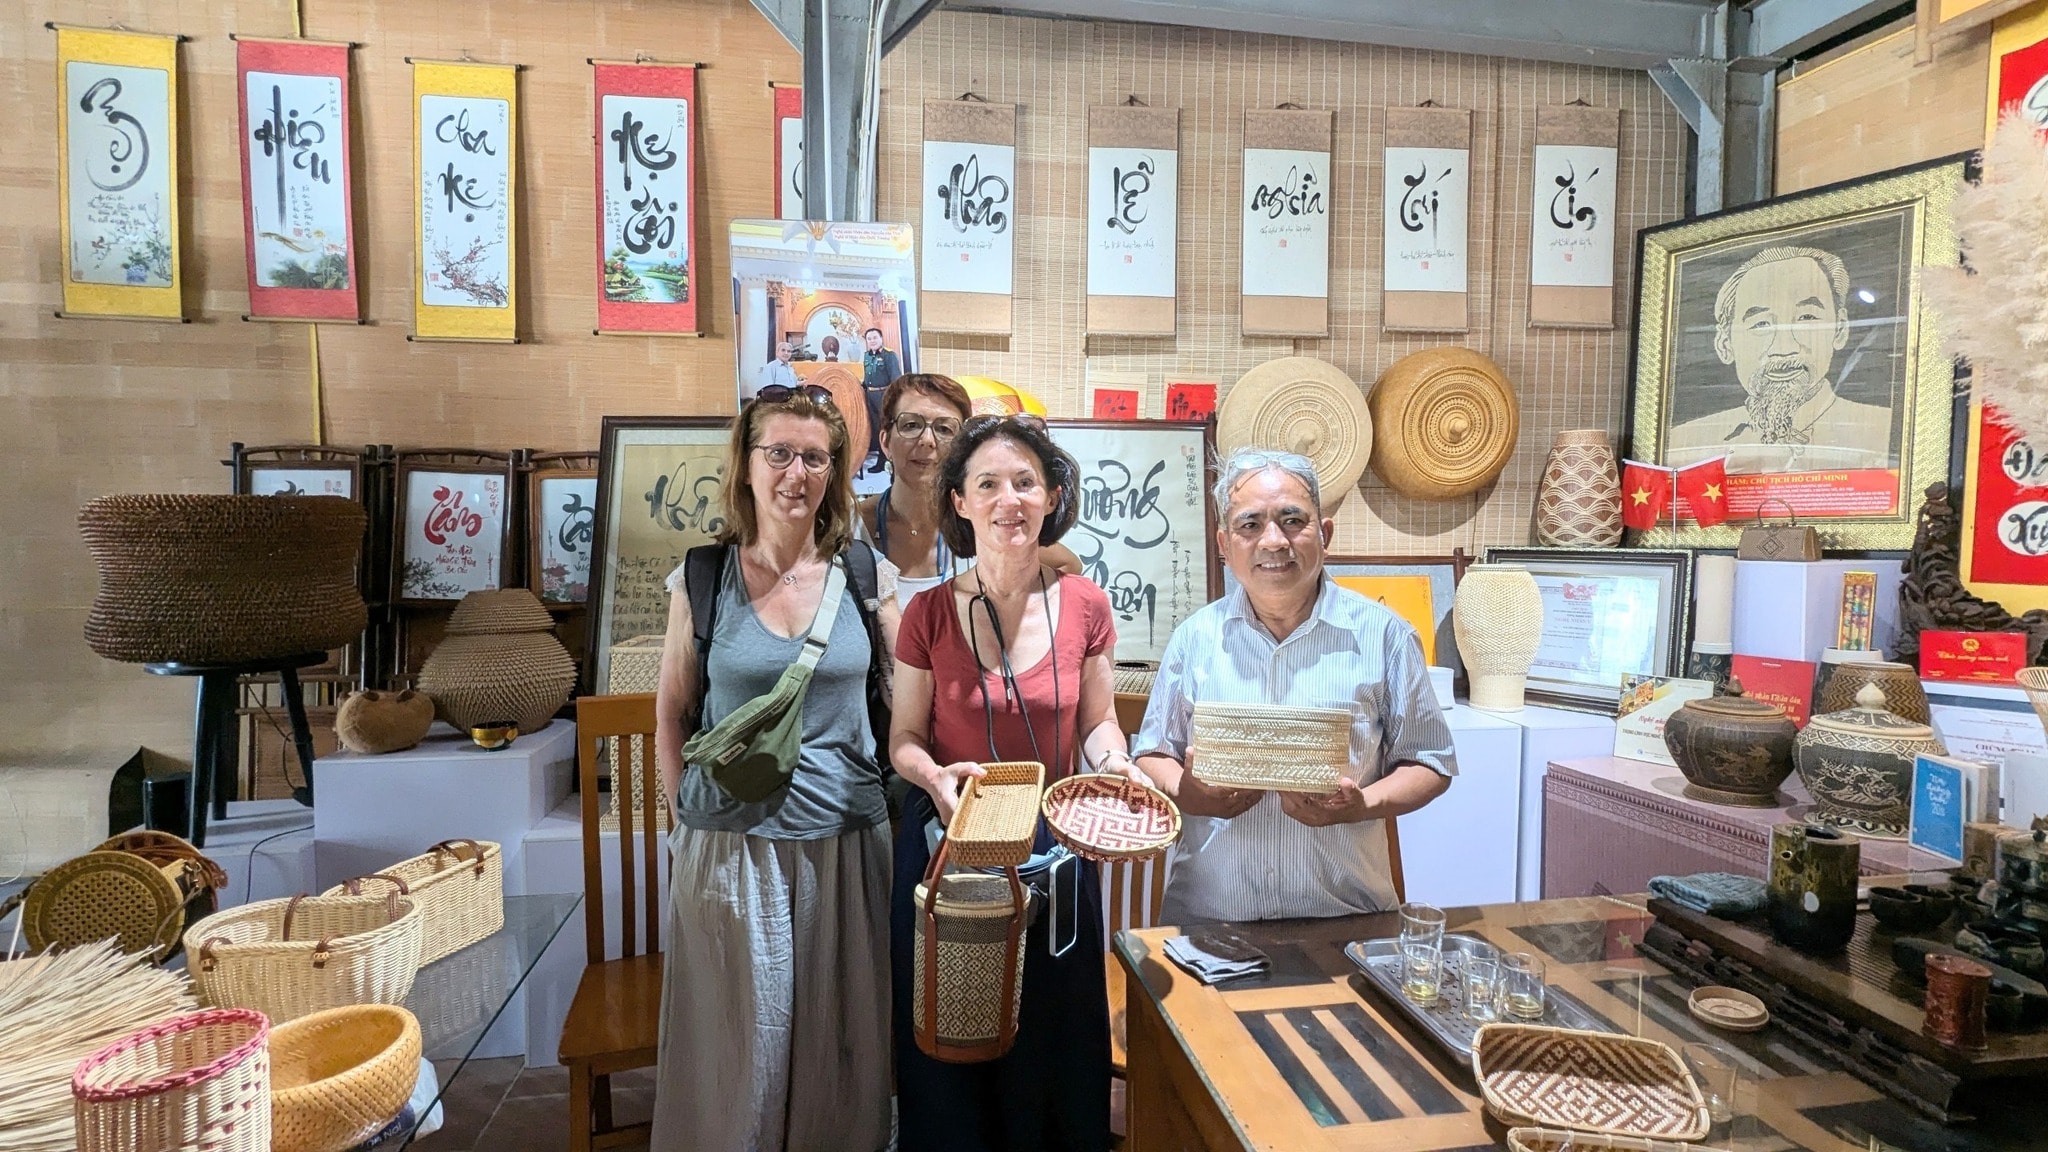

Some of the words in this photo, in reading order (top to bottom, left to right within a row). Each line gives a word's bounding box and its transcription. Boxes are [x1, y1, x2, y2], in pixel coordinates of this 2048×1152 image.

[1750, 475, 1768, 485] CHỦ
[1771, 475, 1790, 486] TỊCH
[1791, 473, 1804, 483] HỒ
[1805, 473, 1821, 482] CHÍ
[1822, 473, 1848, 481] MINH
